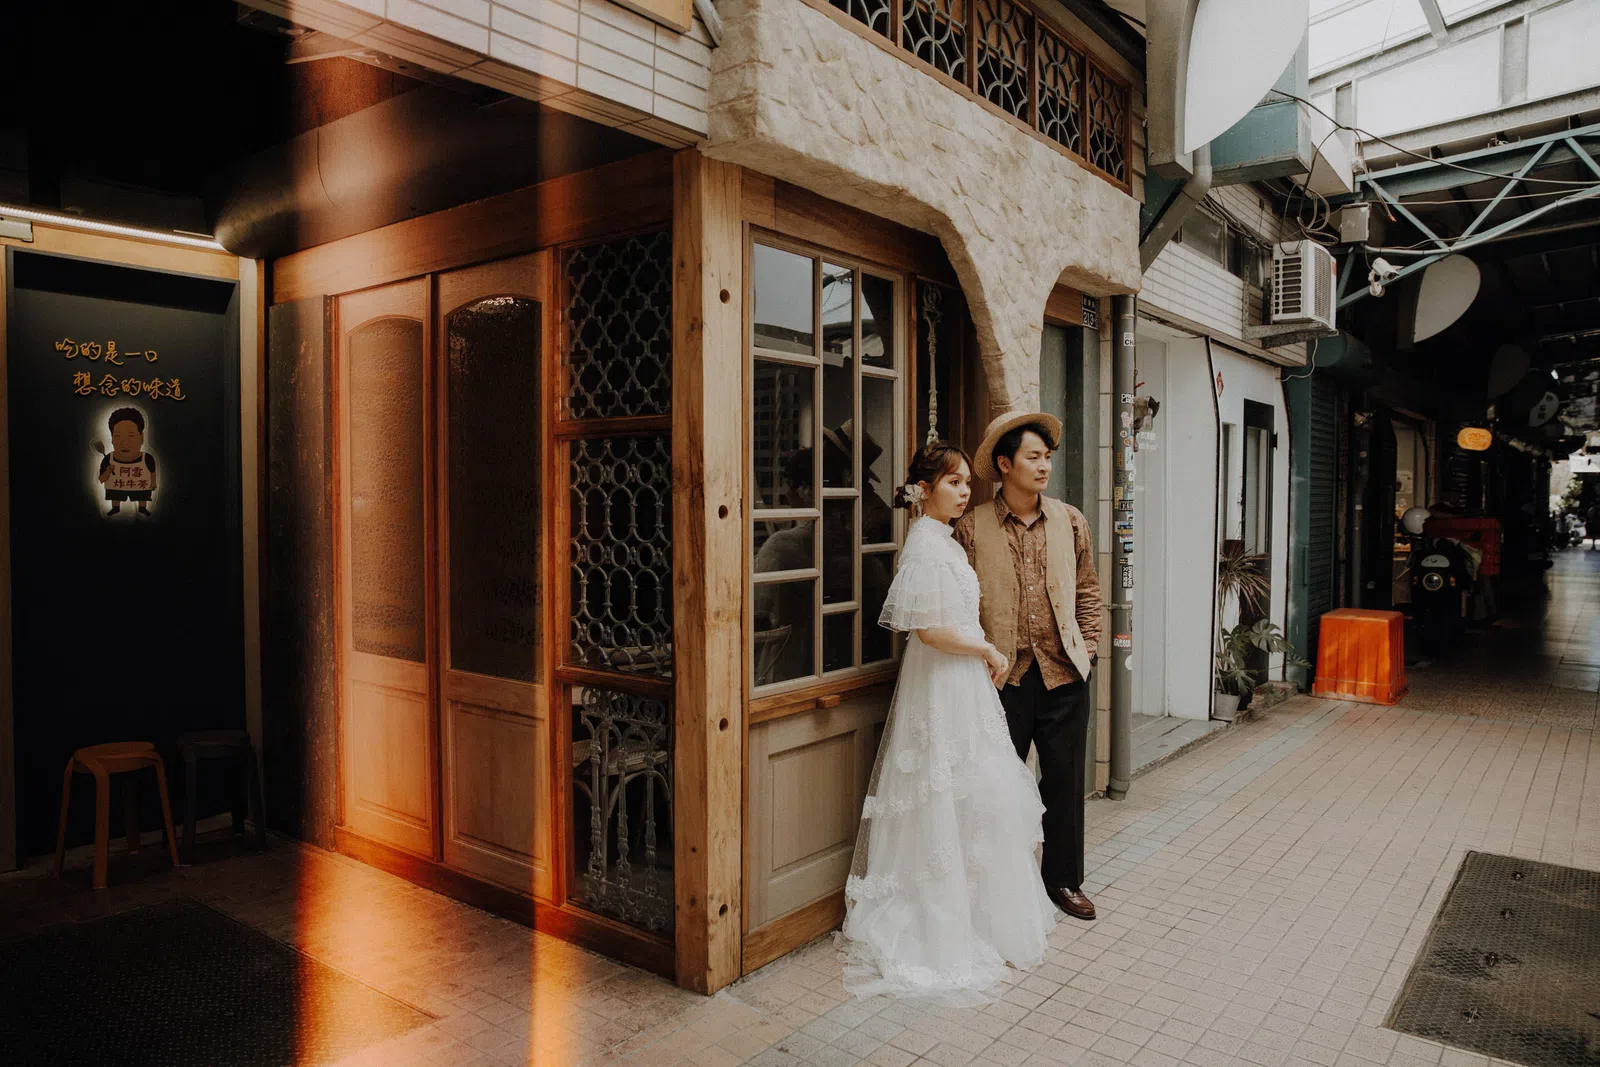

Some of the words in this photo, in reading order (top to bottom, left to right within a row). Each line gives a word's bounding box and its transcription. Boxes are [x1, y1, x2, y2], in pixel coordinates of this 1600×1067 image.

[55, 338, 158, 366] 吃的是一口
[73, 371, 186, 400] 想念的味道
